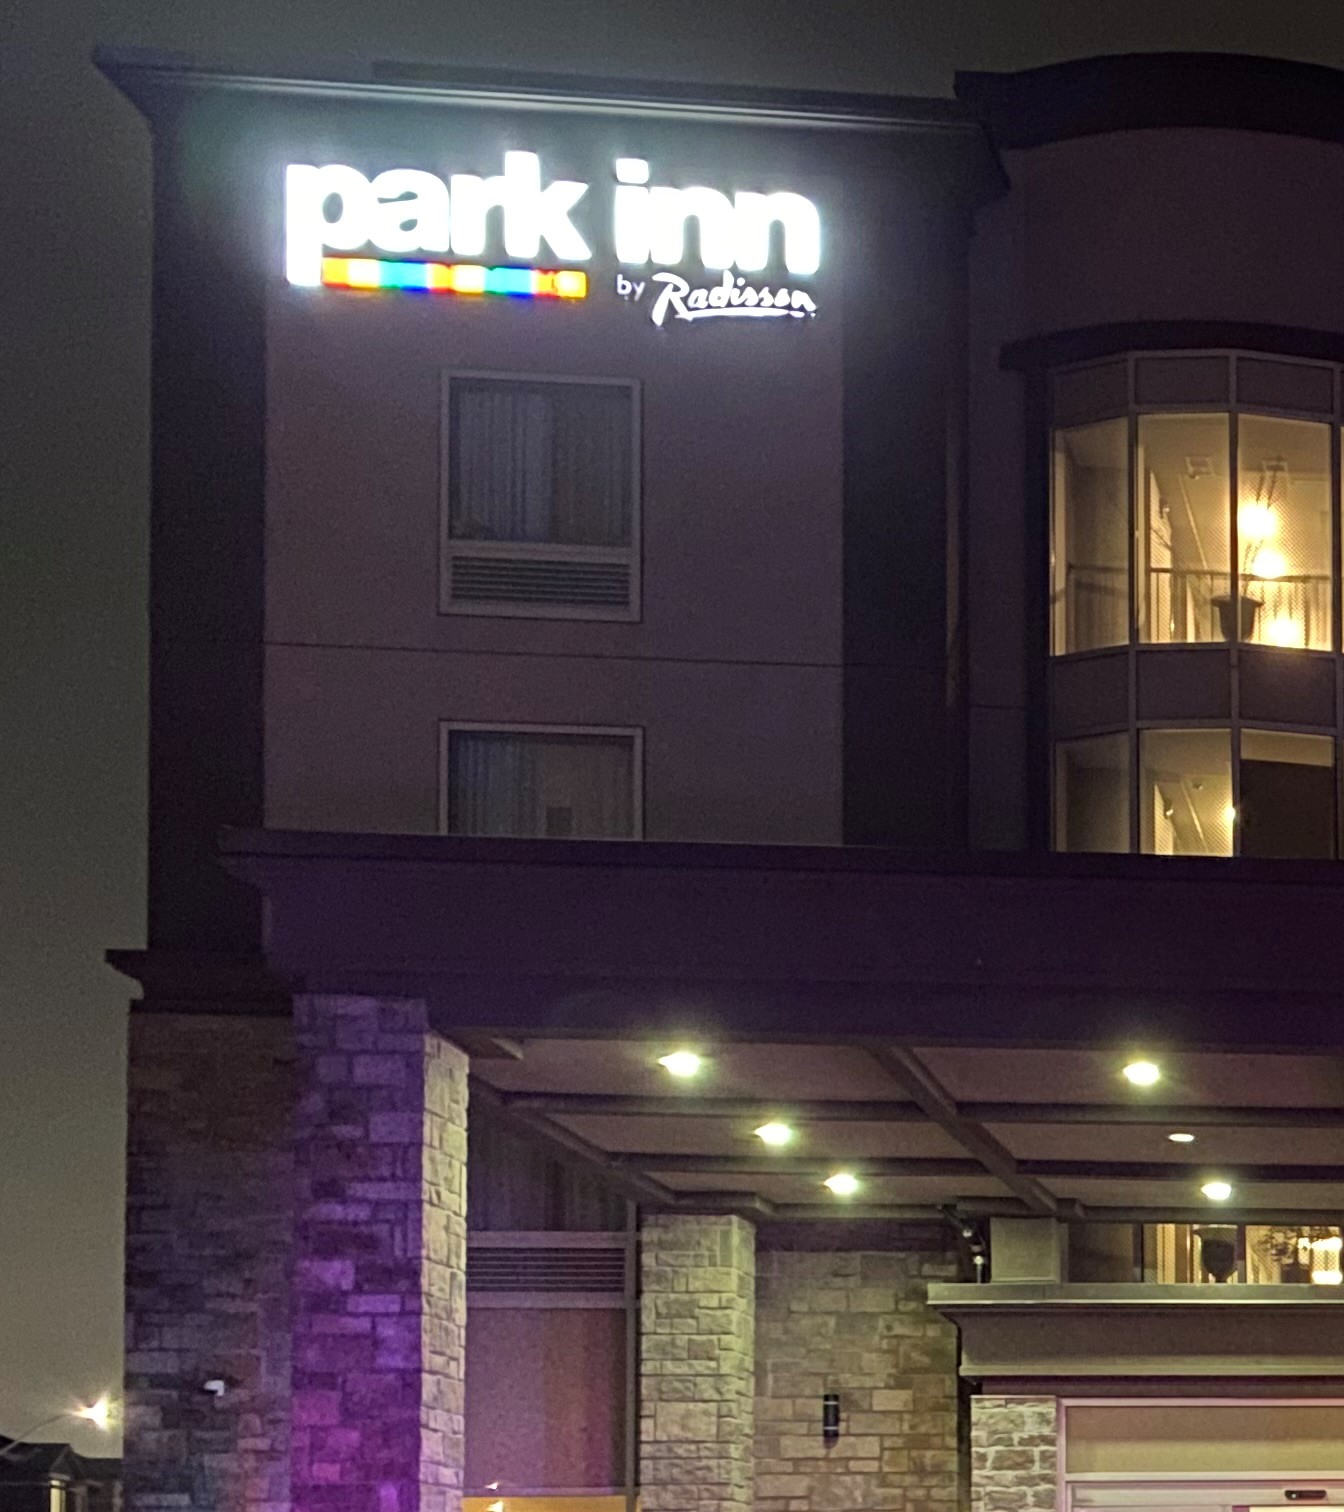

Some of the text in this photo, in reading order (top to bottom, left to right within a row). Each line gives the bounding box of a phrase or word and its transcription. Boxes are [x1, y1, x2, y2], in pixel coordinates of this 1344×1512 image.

[286, 151, 821, 286] park inn
[616, 269, 817, 327] by Radisson
